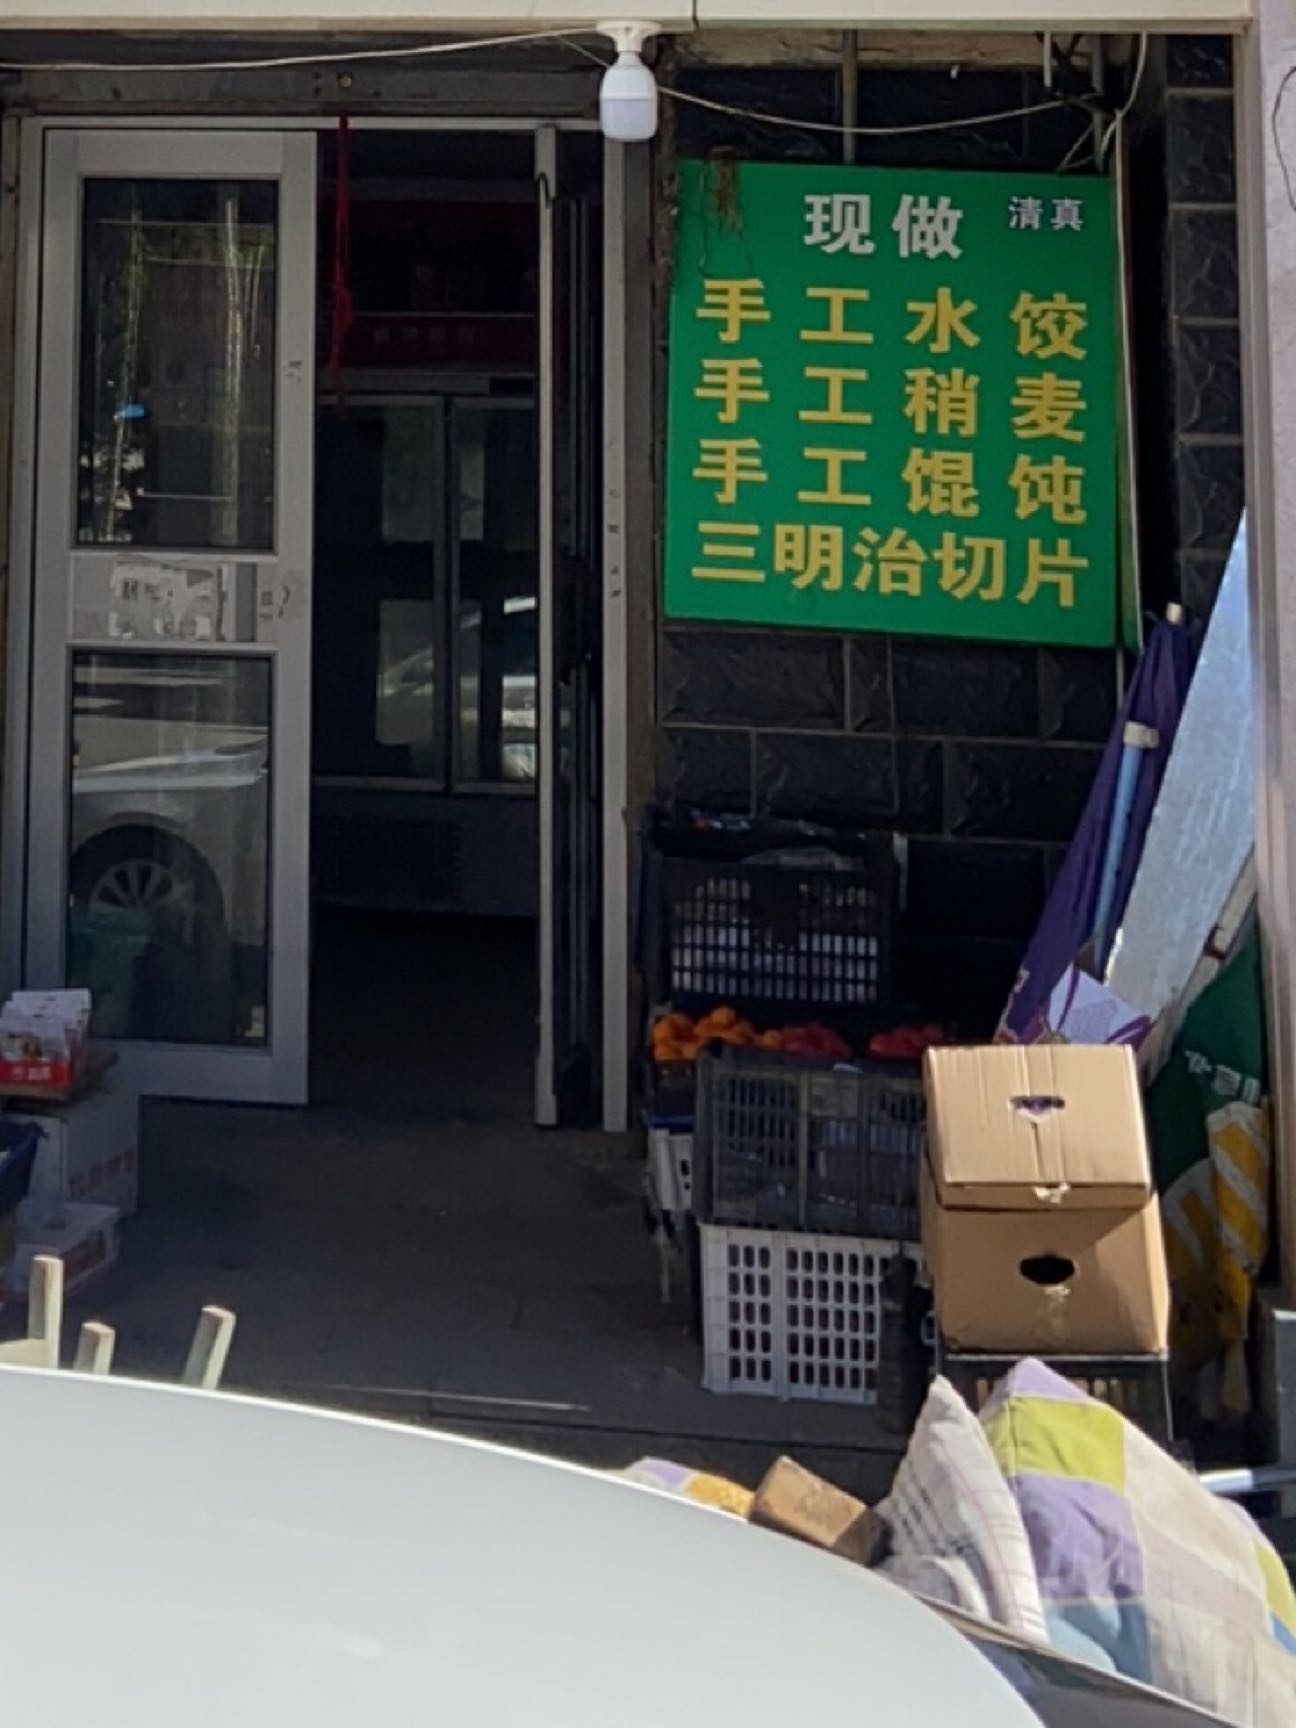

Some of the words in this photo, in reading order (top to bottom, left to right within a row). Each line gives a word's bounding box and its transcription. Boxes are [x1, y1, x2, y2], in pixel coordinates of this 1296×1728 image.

[804, 193, 964, 260] 现做
[1009, 196, 1084, 232] 清真
[696, 278, 1089, 361] 手工水饺
[694, 357, 1088, 443] 手工稍麦
[692, 438, 1088, 525] 手工馄饨
[690, 521, 1090, 608] 三明治切片
